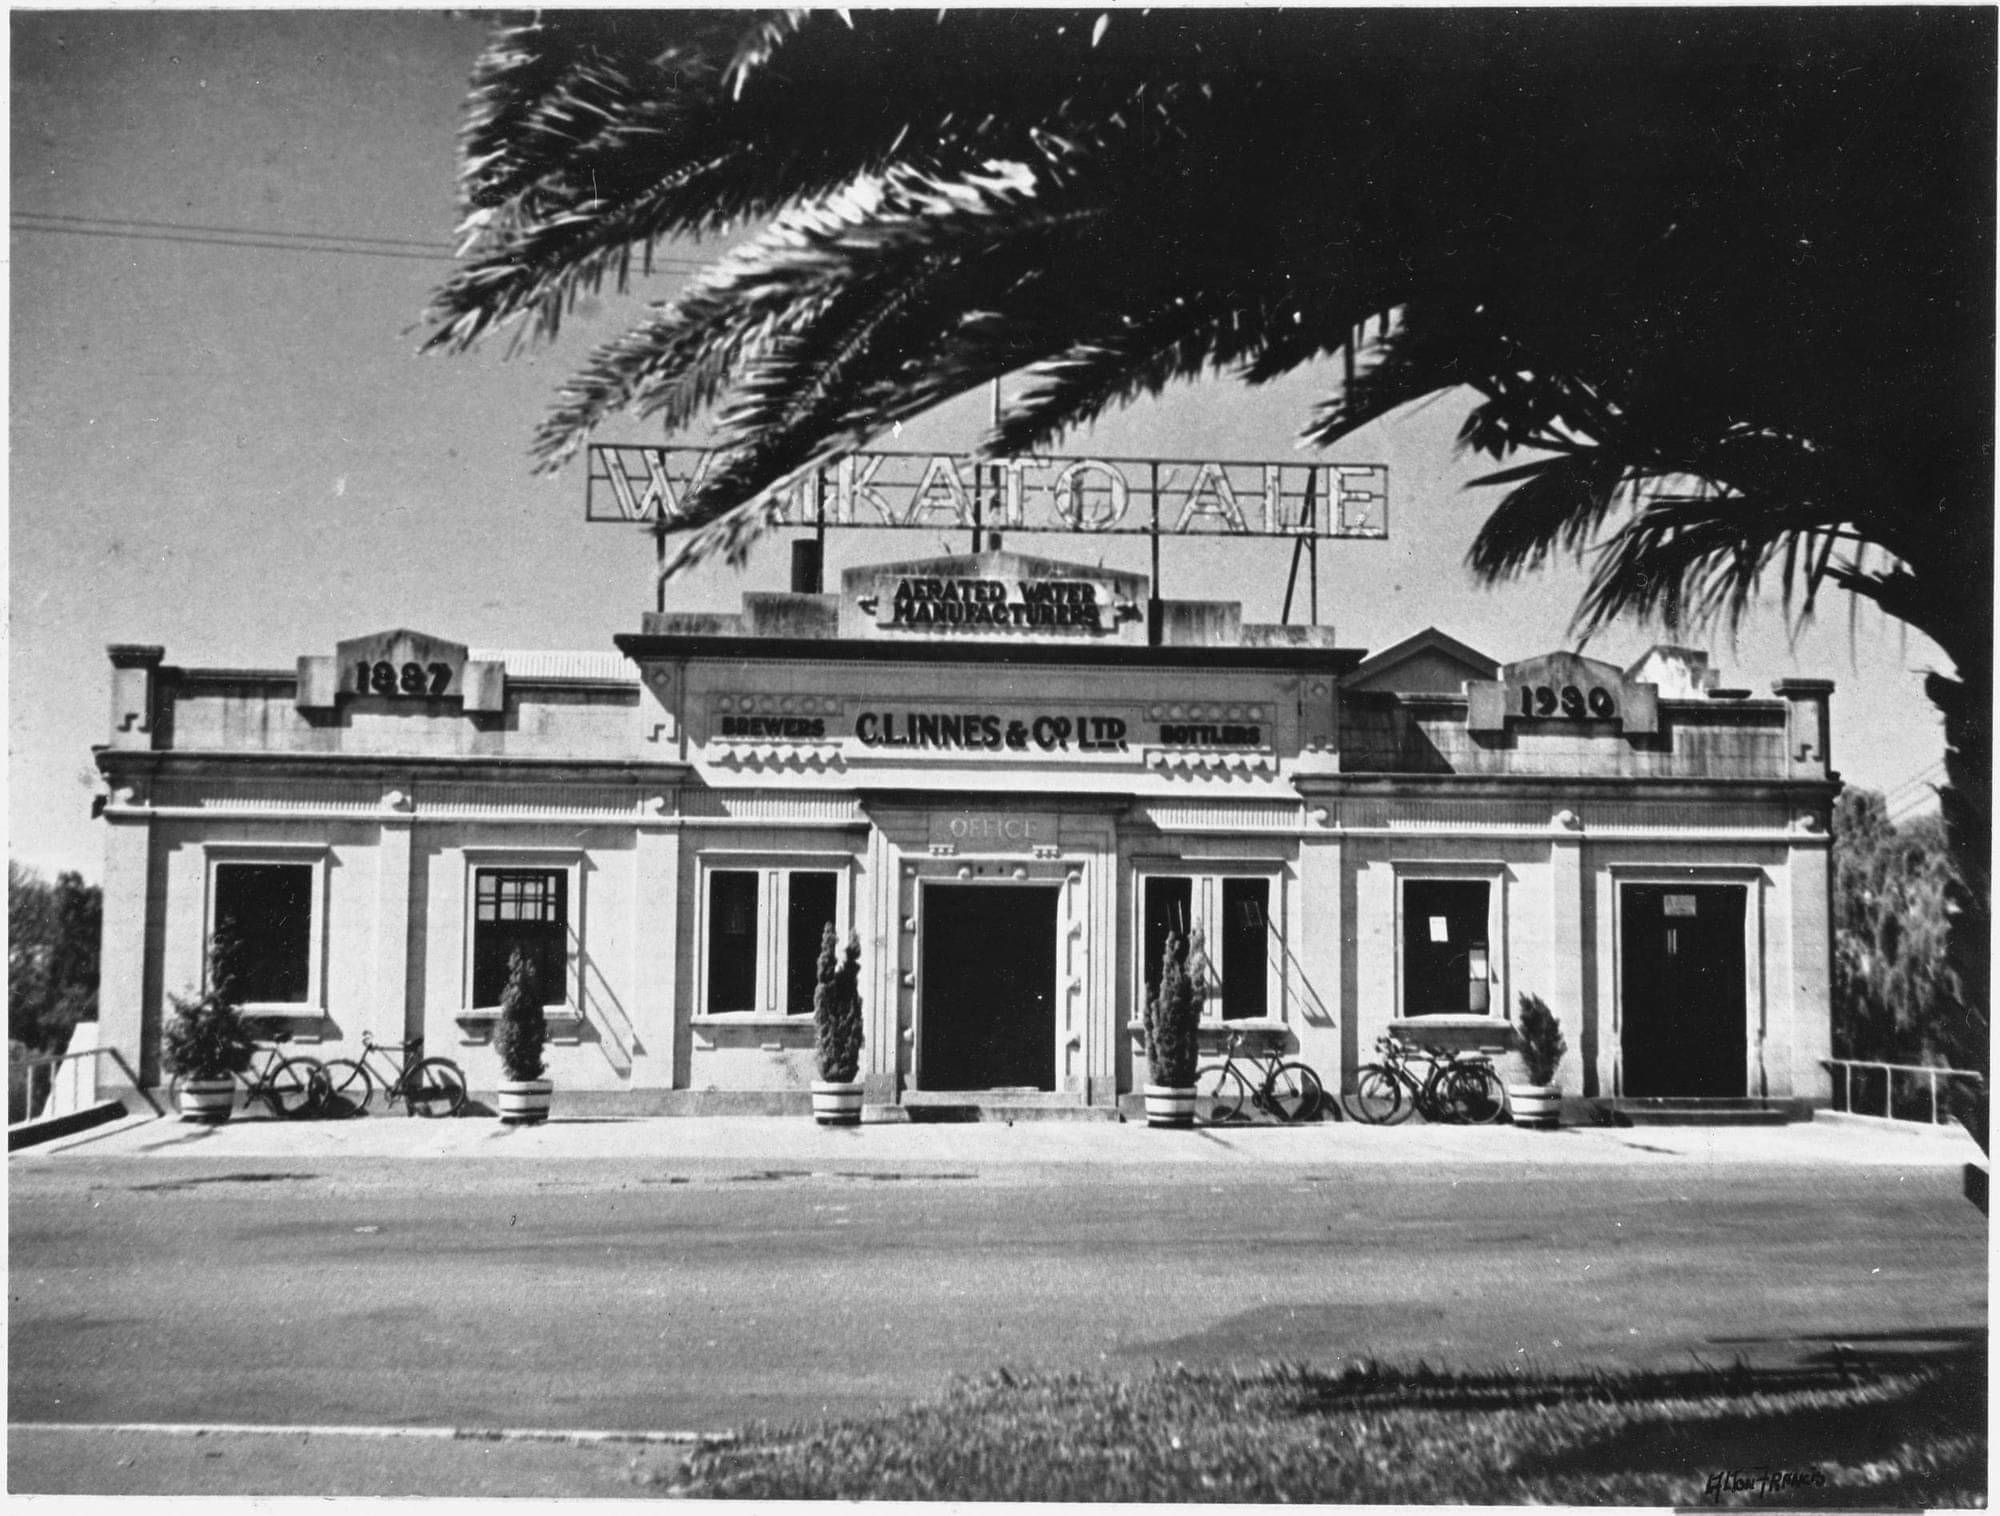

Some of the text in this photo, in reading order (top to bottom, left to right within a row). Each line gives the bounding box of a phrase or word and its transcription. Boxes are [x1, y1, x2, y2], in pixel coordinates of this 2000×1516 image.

[597, 447, 1386, 535] WIKATO ALE
[895, 579, 1097, 603] AERATED WATER
[893, 600, 1101, 628] MANUFACTURERS
[356, 660, 453, 694] 1887
[1520, 685, 1615, 718] 1930
[722, 716, 825, 737] BREWERS
[1005, 720, 1028, 748] &
[1160, 725, 1260, 745] BOTTLERS
[950, 817, 1038, 839] OFFICE
